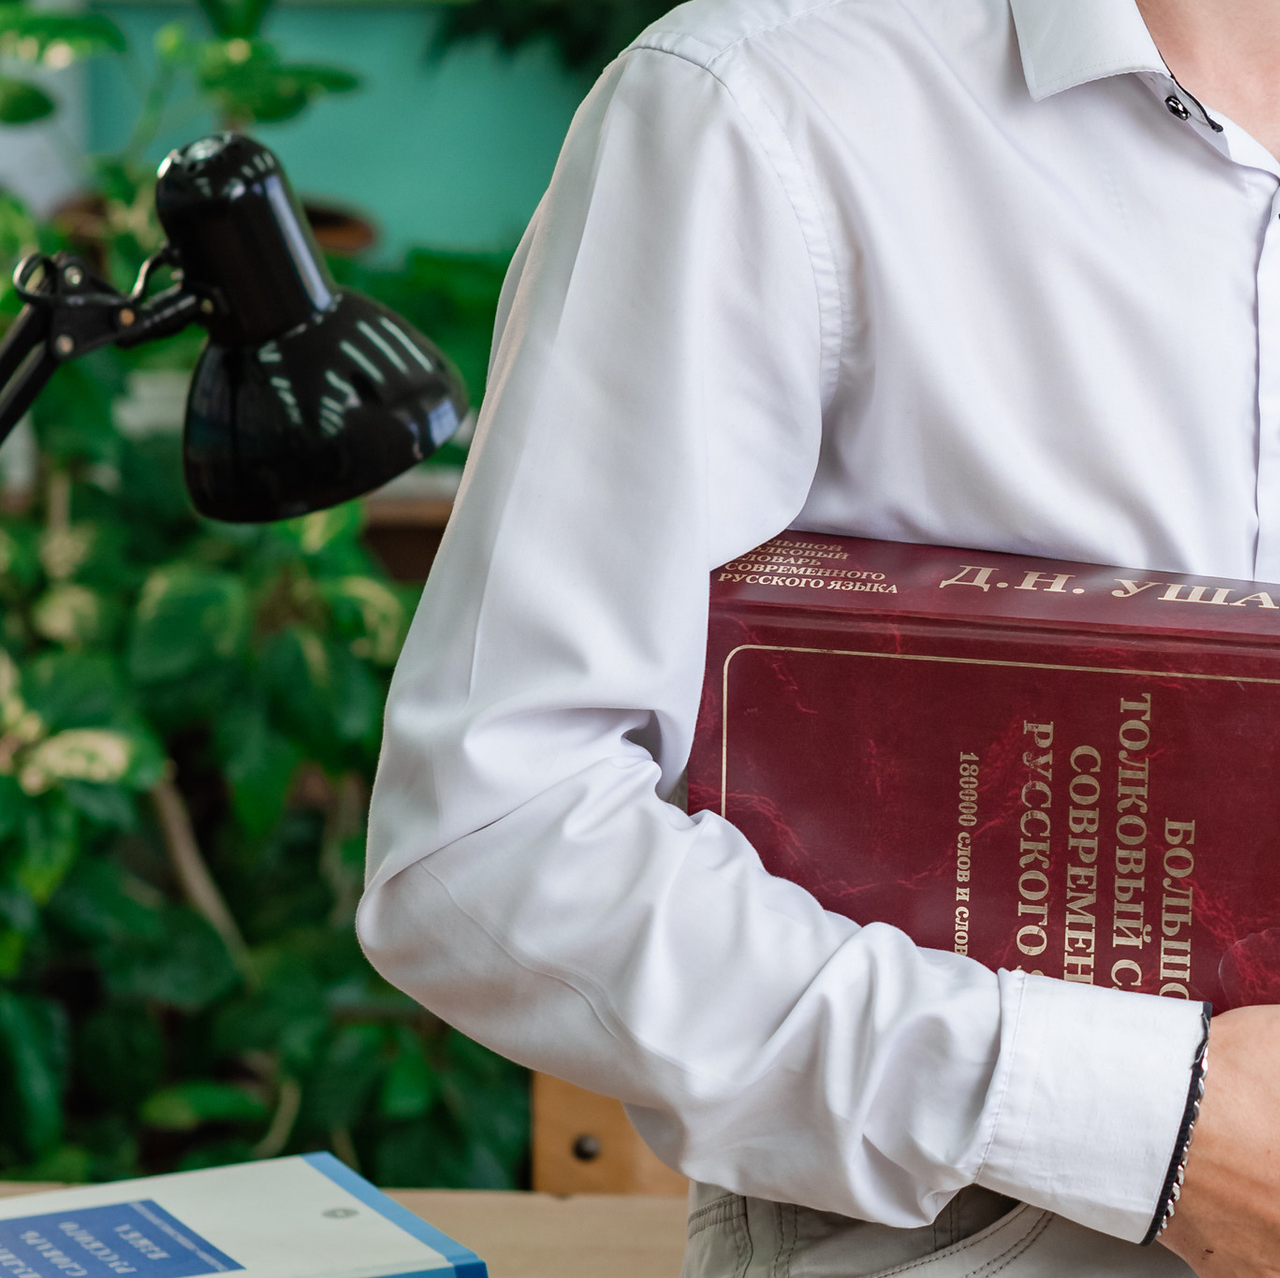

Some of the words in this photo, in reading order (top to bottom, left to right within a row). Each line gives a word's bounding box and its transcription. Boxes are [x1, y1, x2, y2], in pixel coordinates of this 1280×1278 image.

[767, 538, 844, 552] ЛЬШОЙ
[717, 572, 825, 589] РУССКОГО
[827, 579, 898, 594] ЯЗЫКА
[724, 562, 886, 581] СОВРЕМЕННОГО
[939, 565, 1085, 595] Д.Н.
[957, 751, 980, 828] 180000
[1111, 692, 1153, 950] ТОЛКОВЫЙ
[1015, 719, 1054, 957] РУССКОГО
[1063, 744, 1102, 986] СОВРЕМЕН
[1110, 958, 1144, 991] С
